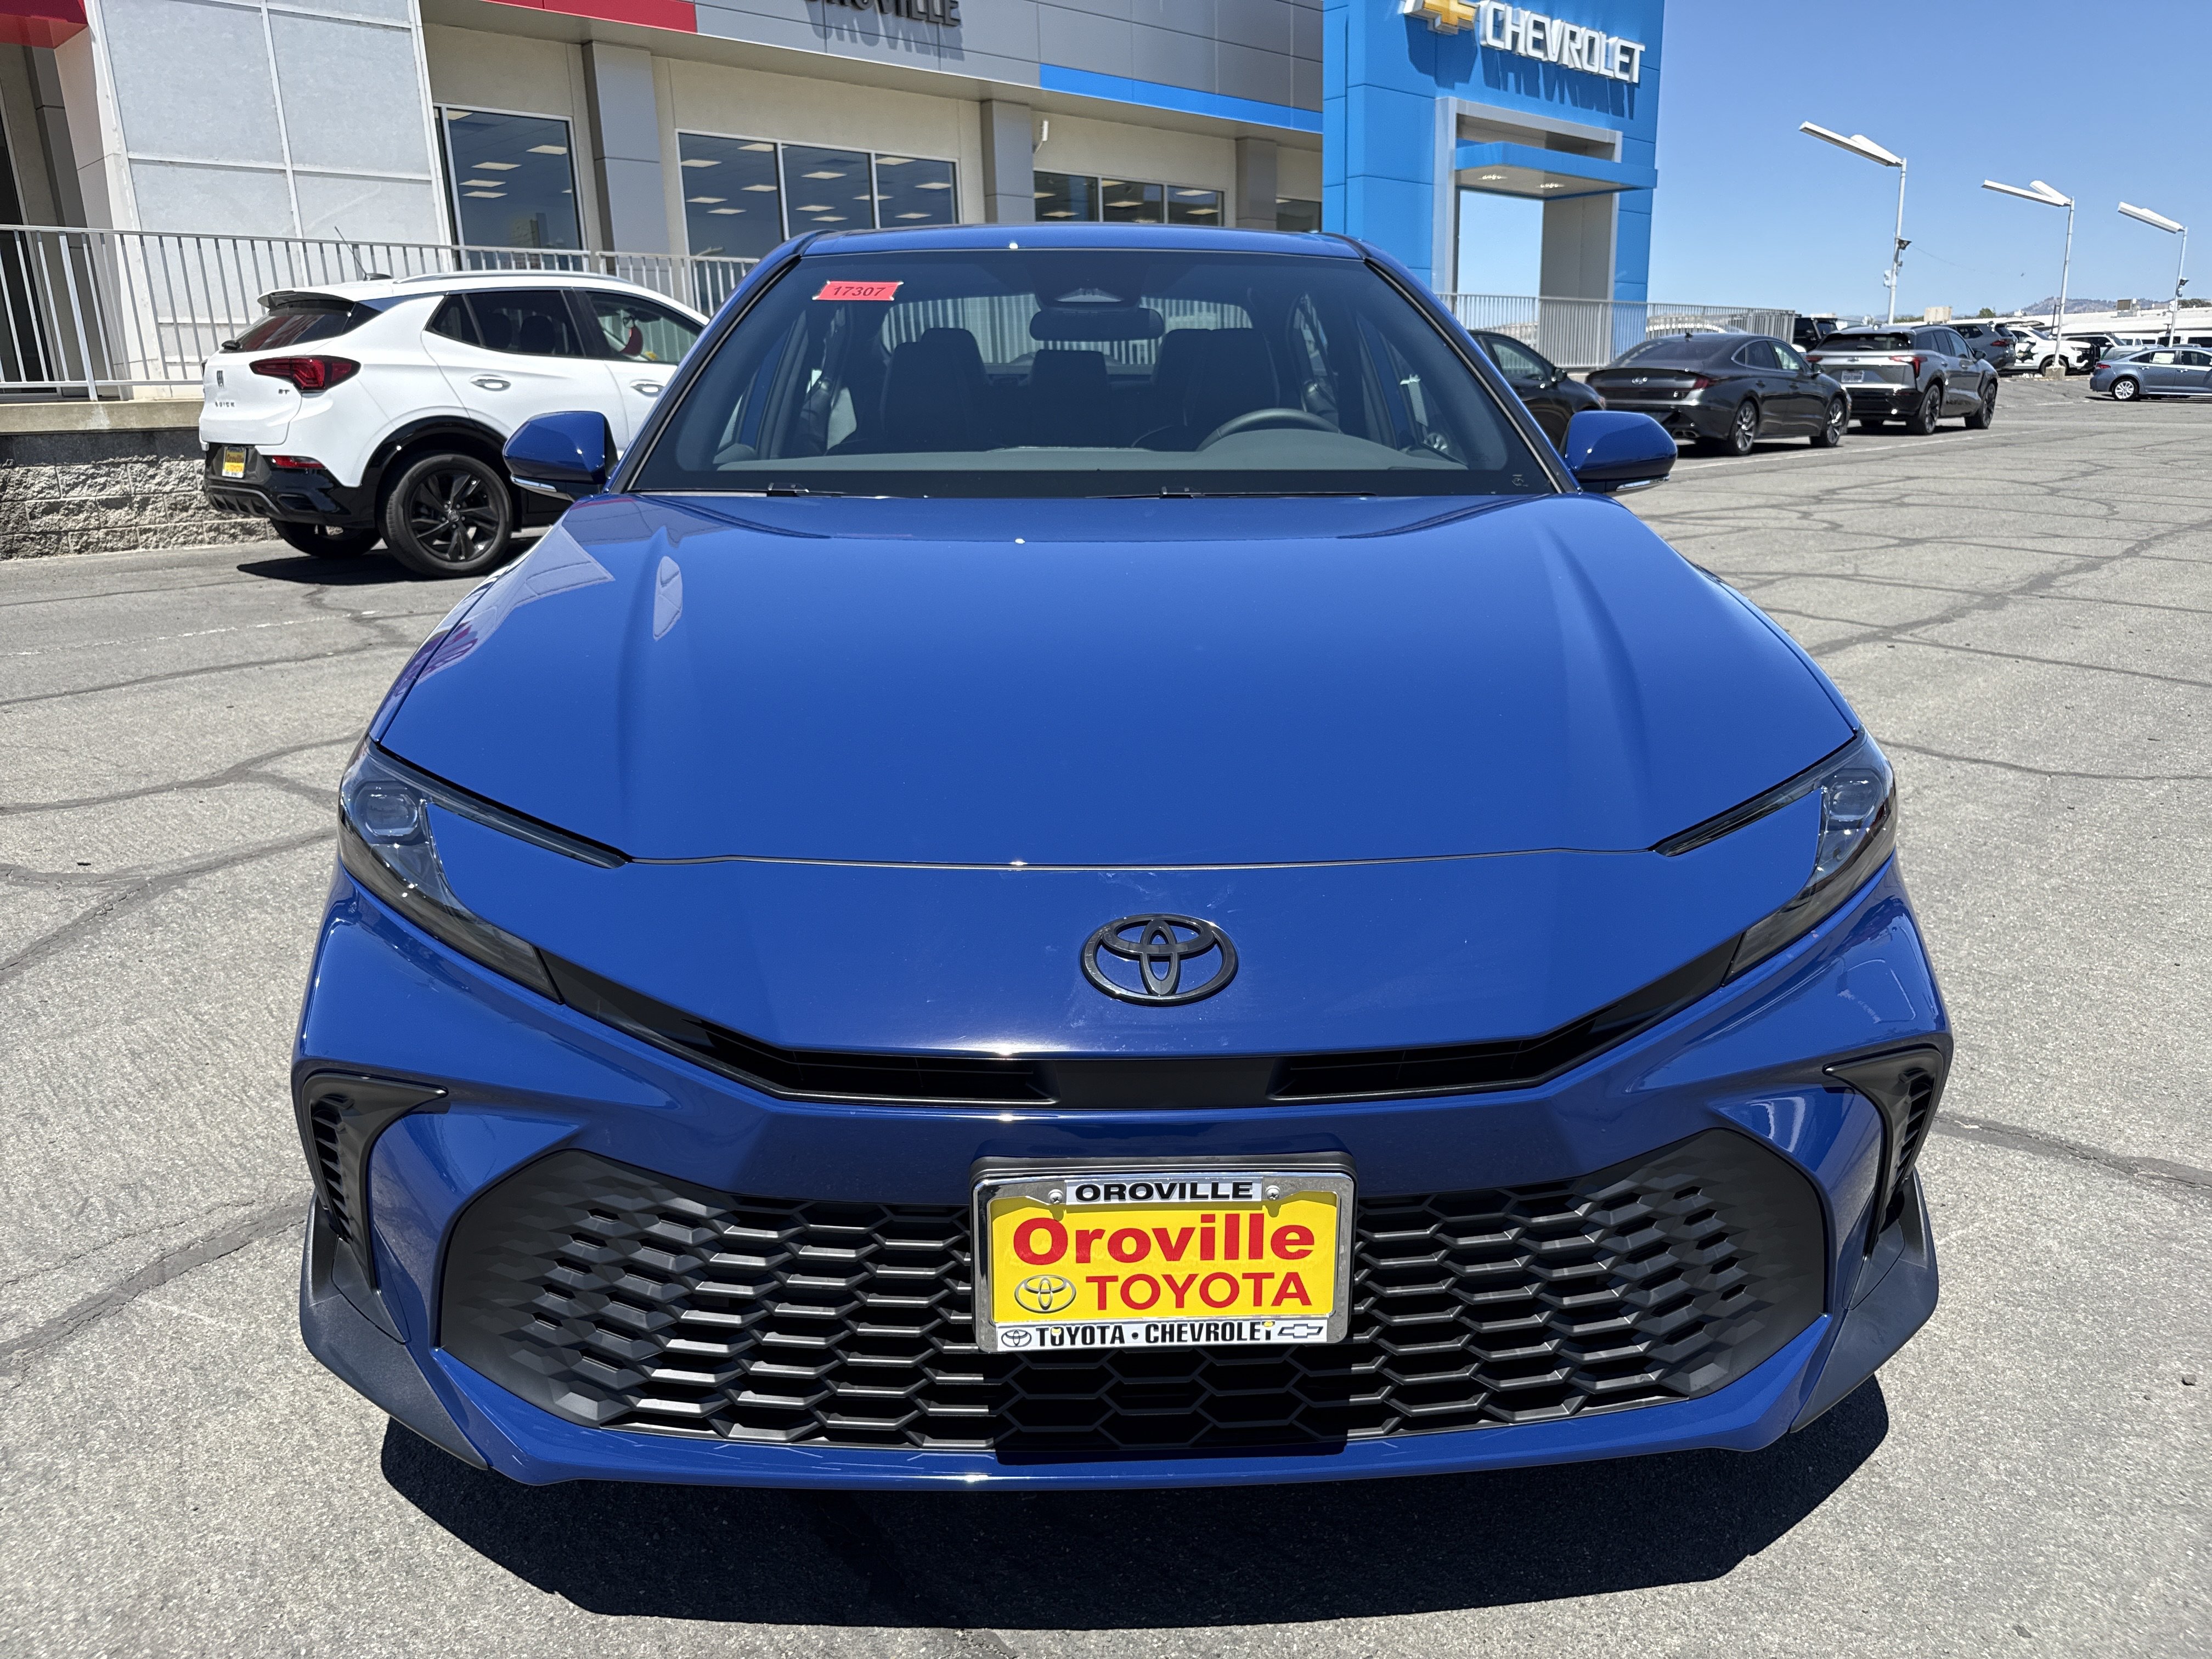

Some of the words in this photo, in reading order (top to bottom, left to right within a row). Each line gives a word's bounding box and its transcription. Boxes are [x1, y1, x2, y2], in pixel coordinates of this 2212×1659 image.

[1480, 0, 1645, 83] CHEVROLET
[834, 286, 886, 296] 17307
[1075, 1181, 1254, 1201] OROVILLE
[1013, 1213, 1314, 1265] Oroville
[1086, 1272, 1312, 1311] TOYOTA
[1036, 1324, 1125, 1346] TOYOTA
[1145, 1321, 1276, 1344] CHEVROLET
